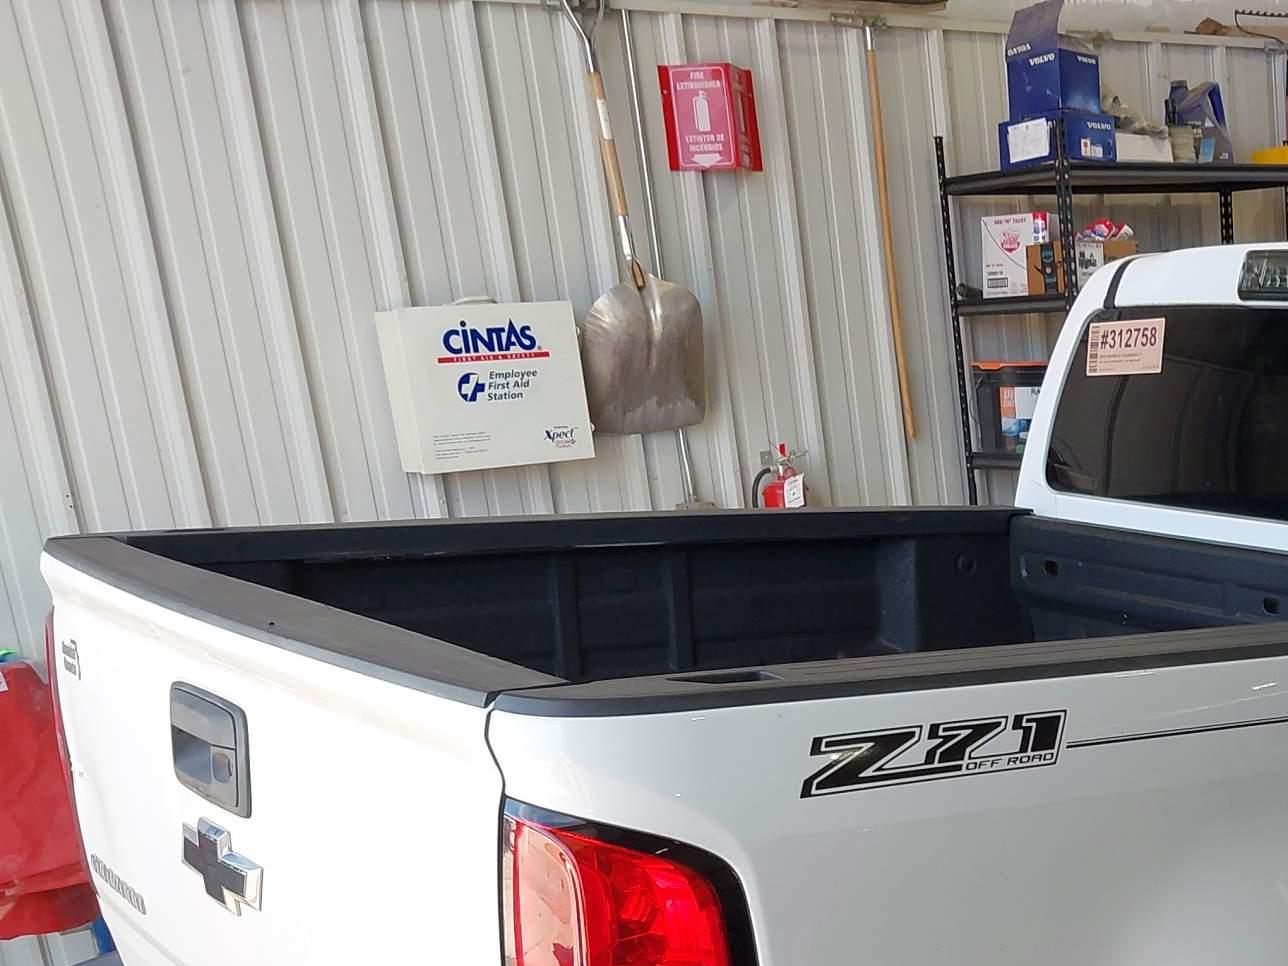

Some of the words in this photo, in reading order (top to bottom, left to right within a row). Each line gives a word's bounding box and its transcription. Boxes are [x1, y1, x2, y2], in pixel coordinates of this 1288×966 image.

[1029, 53, 1055, 66] VOLVO
[1077, 55, 1096, 64] VOLVO
[690, 71, 704, 80] FIRE
[676, 80, 721, 90] EXTINGUISHER
[1087, 121, 1111, 130] VOLVO
[685, 134, 715, 143] EXTINTOR
[716, 133, 724, 142] DE
[1100, 326, 1157, 350] #312758
[489, 369, 538, 381] Employee
[488, 381, 510, 390] First
[513, 379, 530, 389] Aid
[487, 391, 523, 401] Station
[799, 709, 1067, 799] Z71
[965, 758, 1002, 771] OFF
[1007, 752, 1054, 766] ROAD
